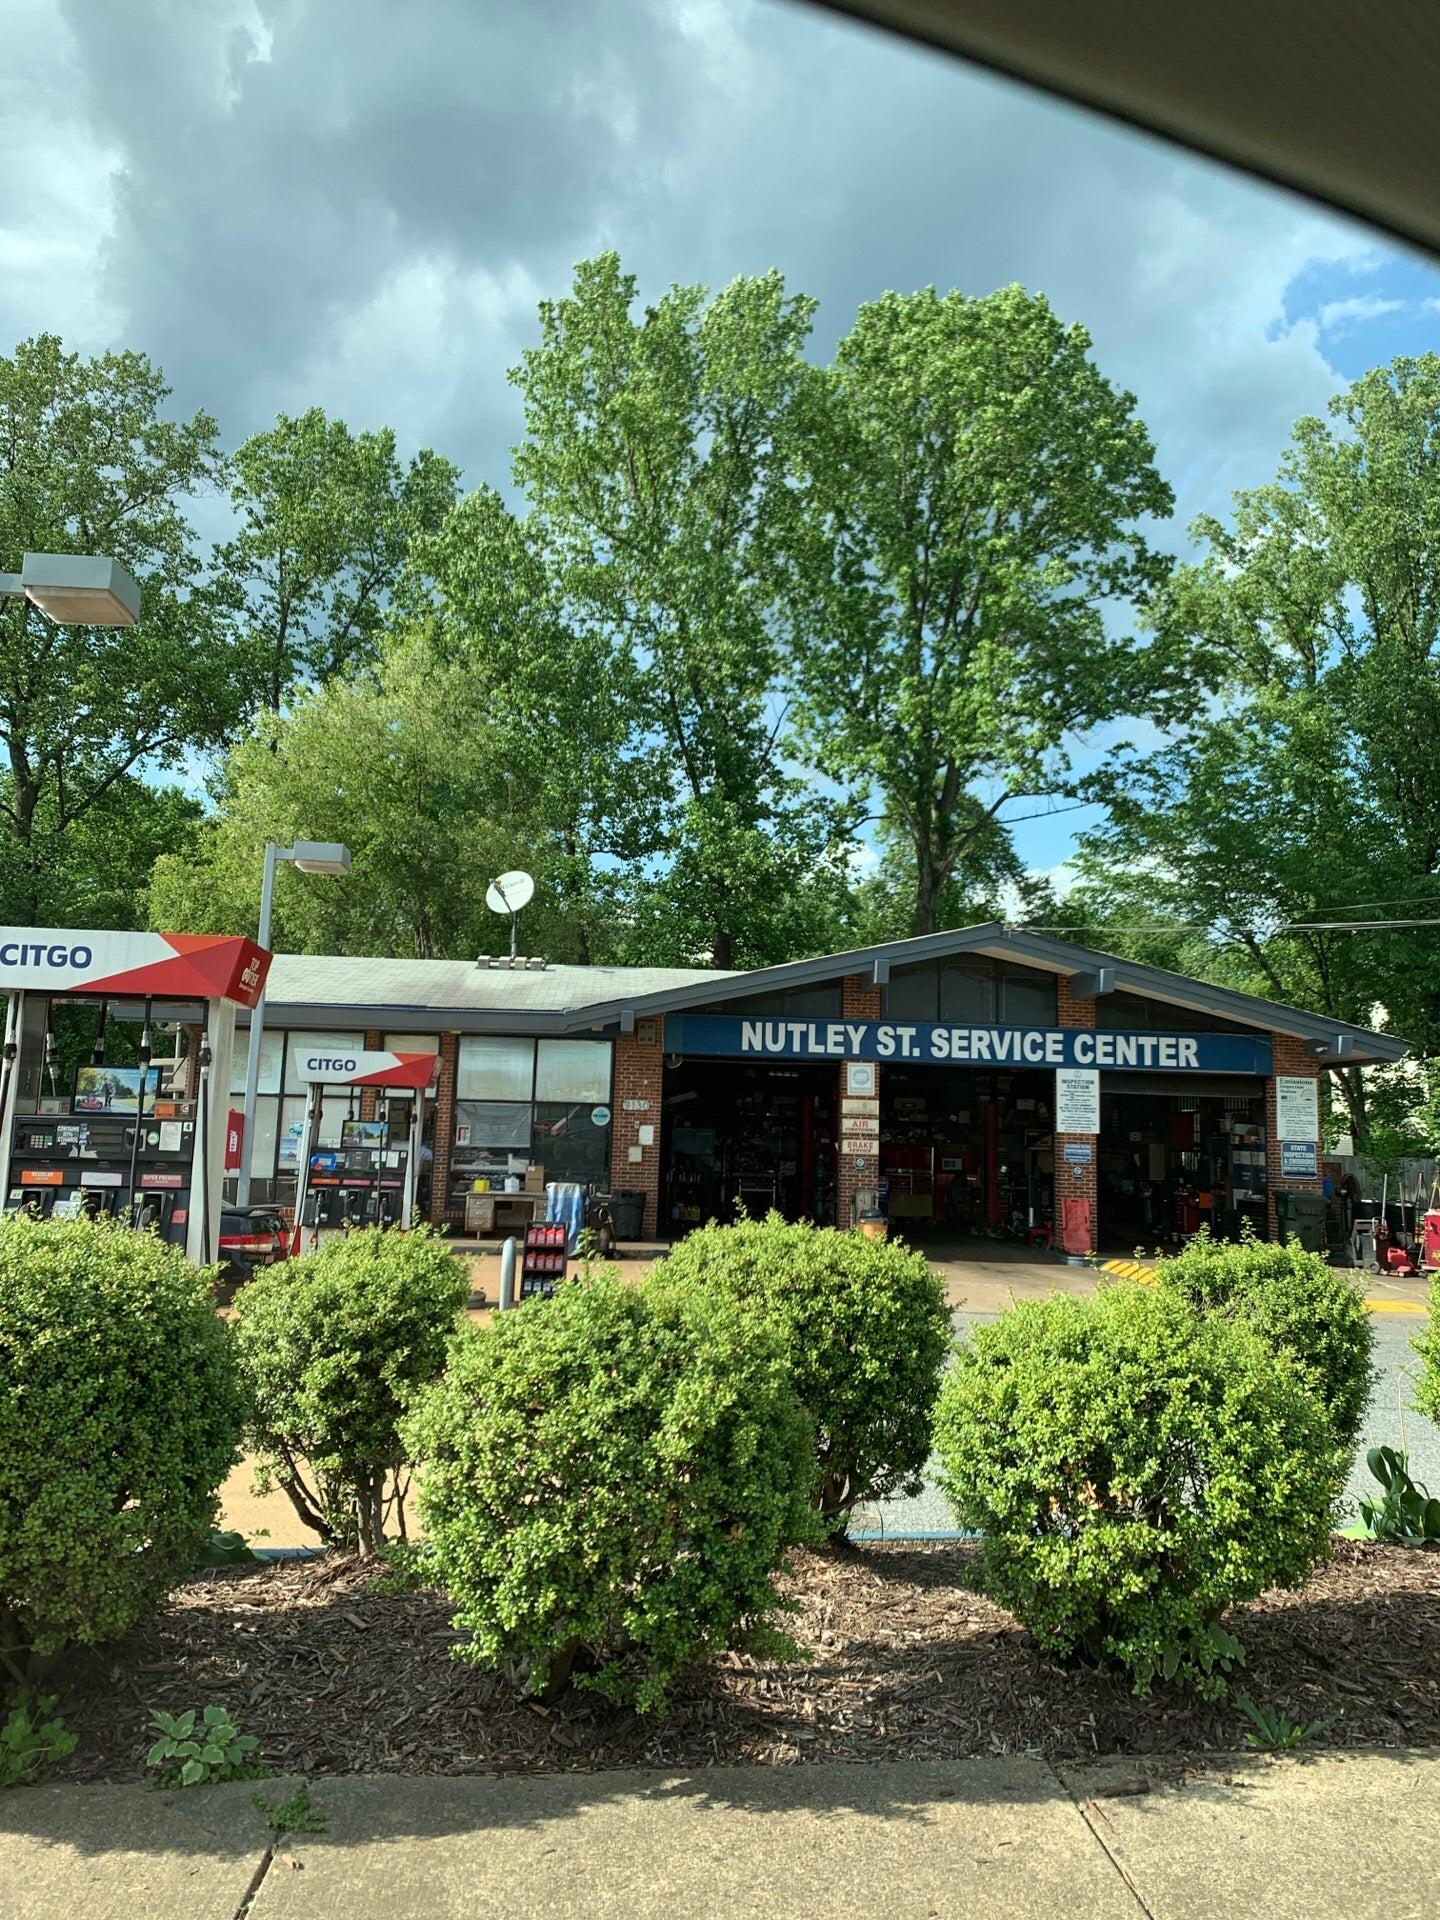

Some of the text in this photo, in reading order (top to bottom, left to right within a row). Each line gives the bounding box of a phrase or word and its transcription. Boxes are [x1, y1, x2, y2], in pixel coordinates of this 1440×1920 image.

[0, 943, 93, 969] CITGO
[741, 1022, 1200, 1067] NUTLEY ST. SERVICE CENTER
[307, 1057, 357, 1072] CITGO
[853, 1120, 869, 1128] AIR
[847, 1141, 874, 1149] BRAKE
